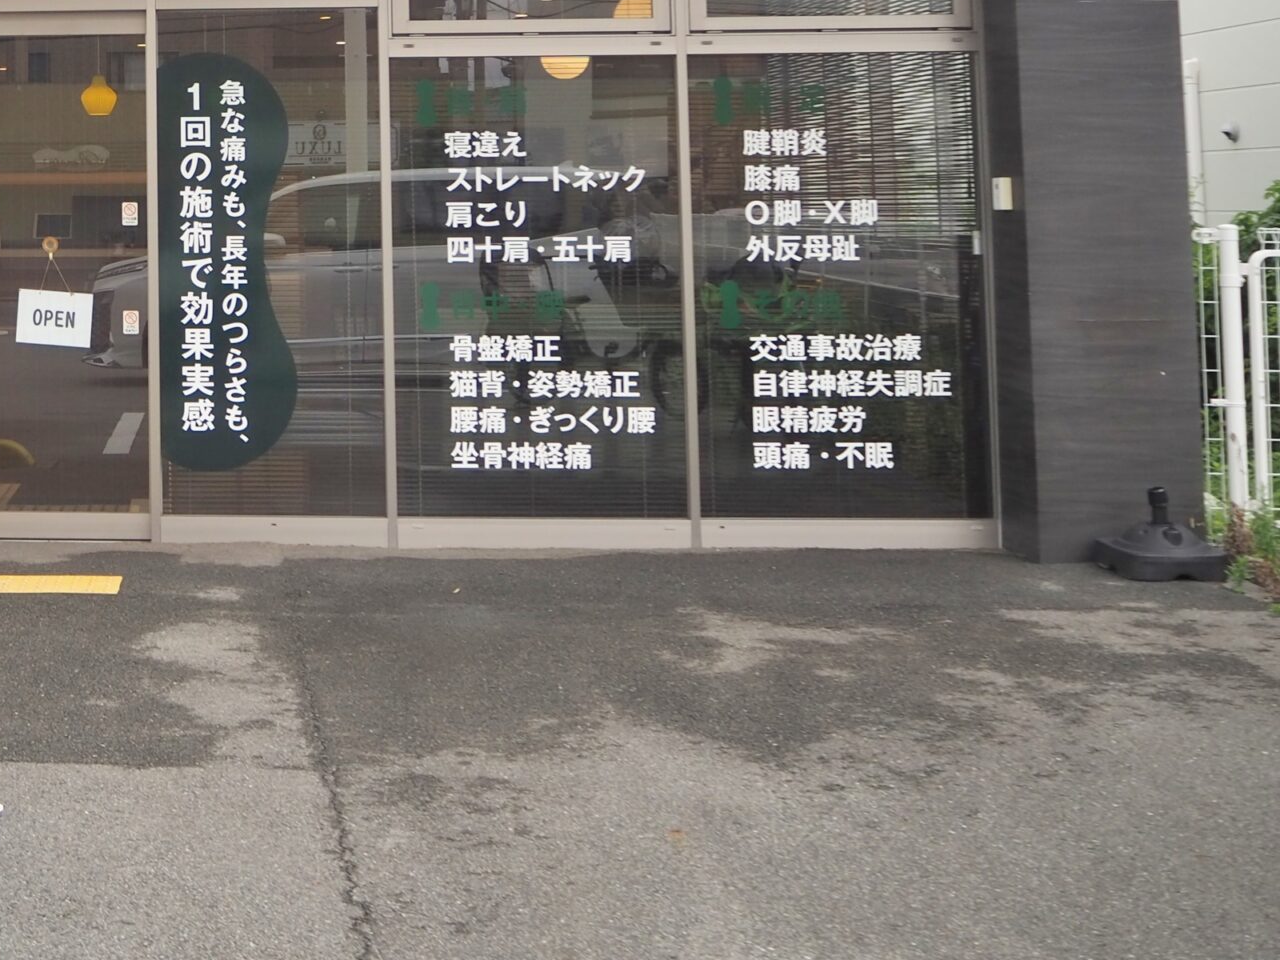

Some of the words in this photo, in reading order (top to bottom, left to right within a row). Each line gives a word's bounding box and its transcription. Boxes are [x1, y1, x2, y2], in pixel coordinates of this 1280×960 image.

[444, 130, 527, 158] 寝違え
[743, 128, 826, 156] 腱鞘炎
[446, 165, 646, 192] ストレートネック
[744, 164, 800, 191] 膝痛
[445, 201, 526, 228] 肩こり
[179, 82, 215, 432] 1回の施術で効果実感
[219, 79, 249, 443] 急な痛みも、長年のつらさも、
[447, 235, 632, 263] 四十肩・五十肩
[746, 234, 860, 262] 外反母趾
[33, 308, 75, 328] OPEN
[449, 334, 562, 362] 骨盤矯正
[749, 333, 921, 362] 交通事故治療
[449, 370, 640, 398] 猫背・姿勢矯正
[753, 369, 952, 397] 自律神経失調症
[450, 406, 656, 434] 腰痛・ぎっくり腰
[752, 405, 866, 433] 眼精疲労
[451, 441, 592, 470] 坐骨神経痛
[753, 441, 894, 469] 頭痛・不眠
